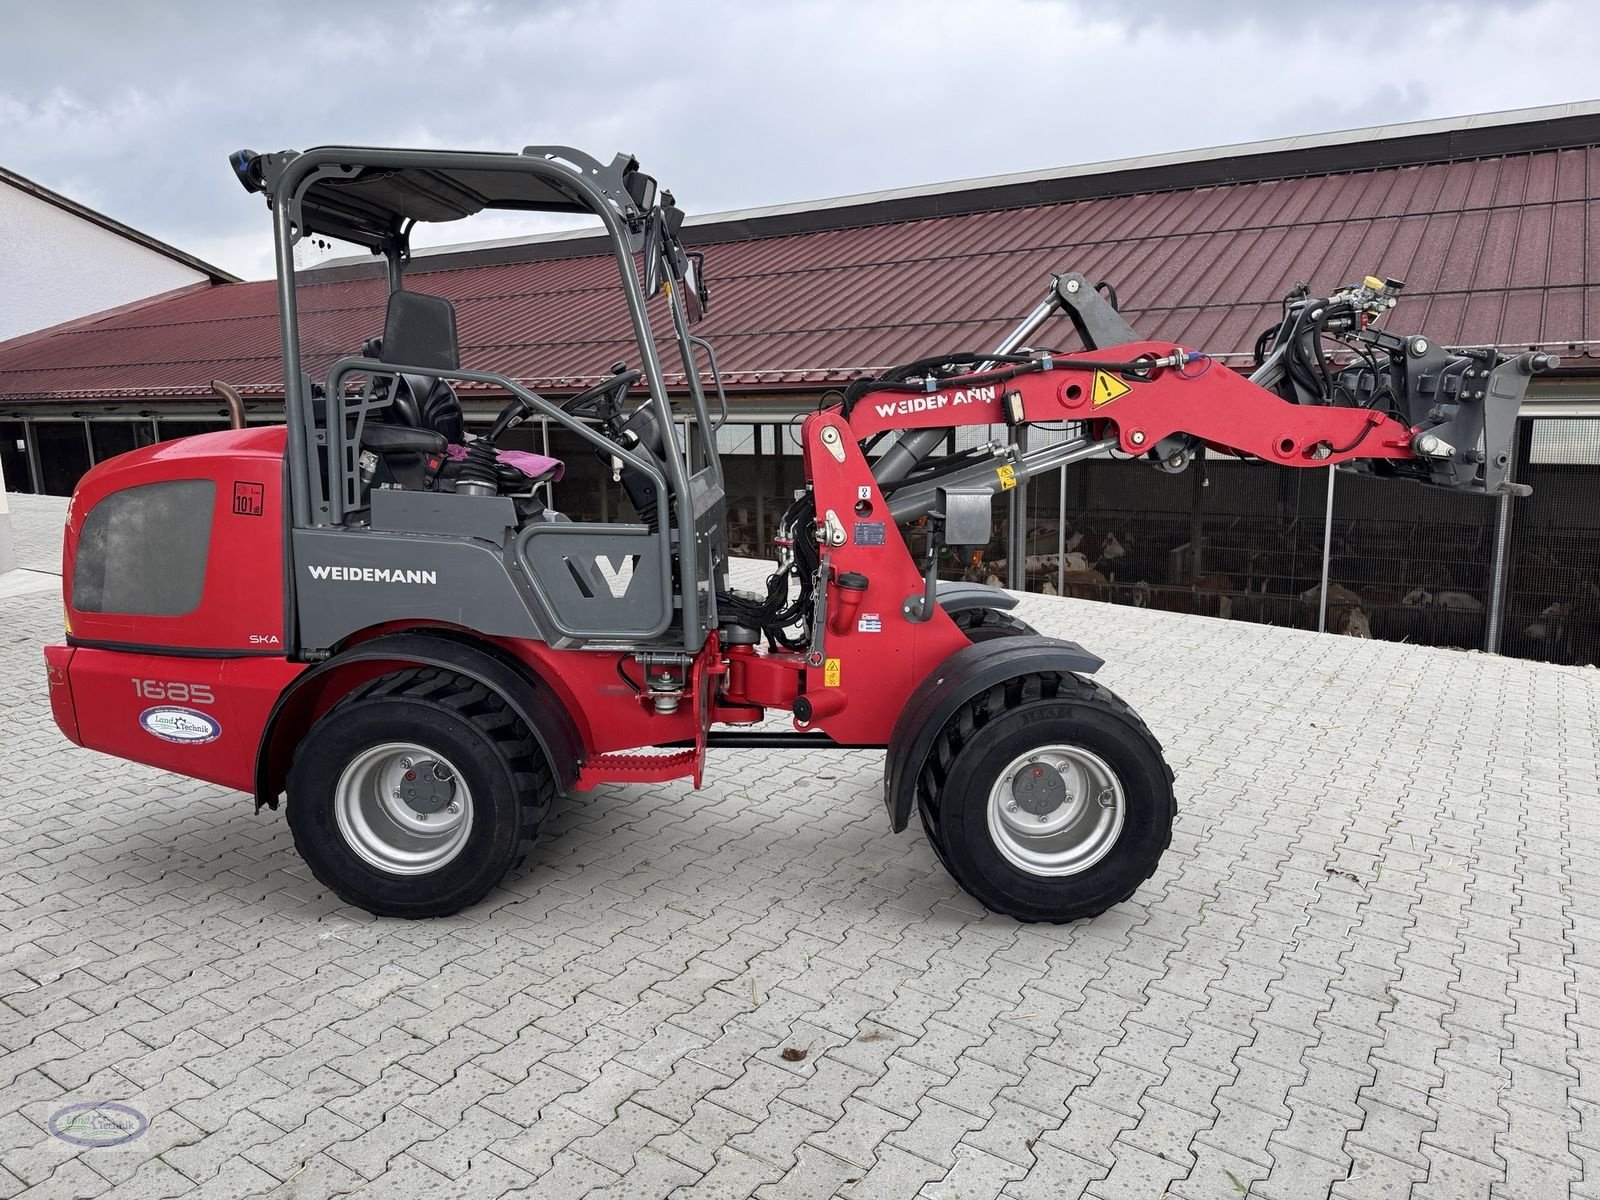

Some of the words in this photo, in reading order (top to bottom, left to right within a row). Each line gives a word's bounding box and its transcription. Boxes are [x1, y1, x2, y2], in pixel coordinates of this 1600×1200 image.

[236, 496, 252, 512] 101
[308, 565, 437, 585] WEIDEMANN
[249, 634, 279, 644] SKA
[131, 678, 215, 704] 1685
[155, 715, 174, 725] Land
[180, 723, 209, 733] Technik
